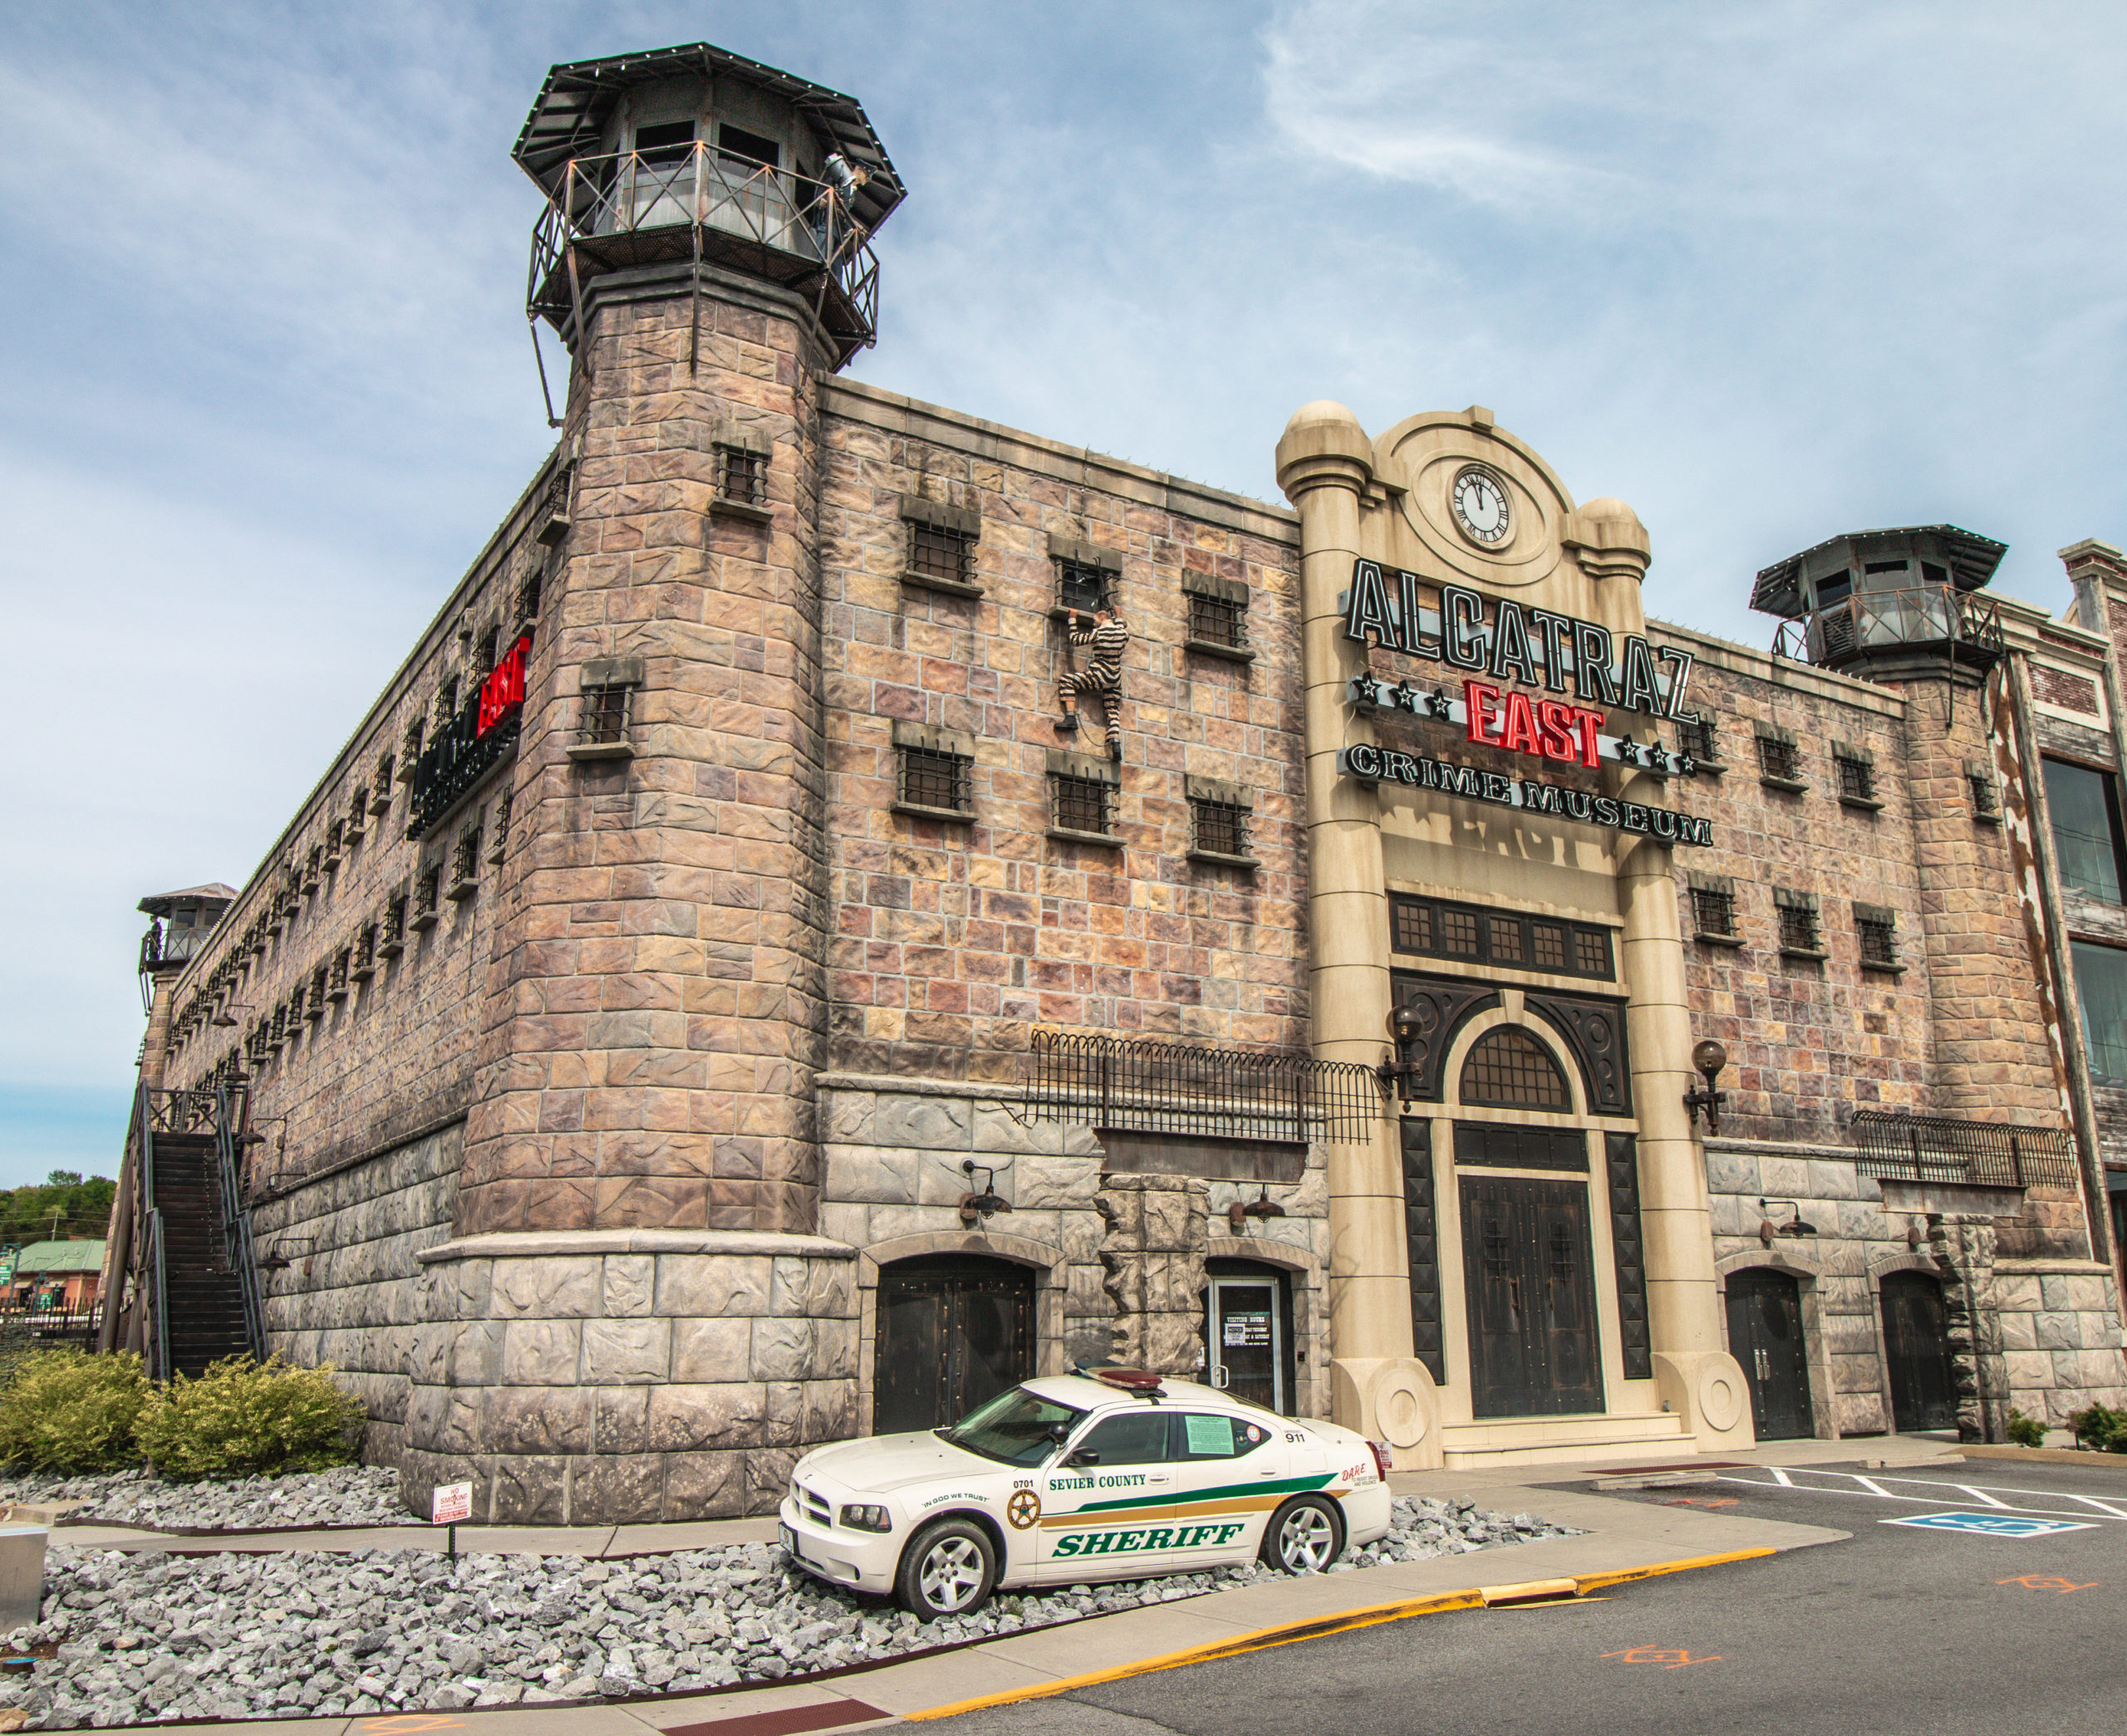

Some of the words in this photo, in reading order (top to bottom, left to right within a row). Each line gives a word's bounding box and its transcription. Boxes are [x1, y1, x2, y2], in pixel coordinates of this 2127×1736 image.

[1343, 557, 1700, 725] ALCATRAZ
[1463, 679, 1604, 769] EAST
[1345, 743, 1511, 804] CRIME
[1517, 779, 1713, 847] MUSEUM
[1285, 1433, 1305, 1443] 911
[1014, 1479, 1034, 1488] 0701
[1049, 1477, 1094, 1491] SEVIER
[1098, 1474, 1146, 1488] COUNTY
[440, 1493, 467, 1503] SMOKING
[932, 1494, 950, 1504] GOD
[1051, 1523, 1245, 1557] SHERIFF
